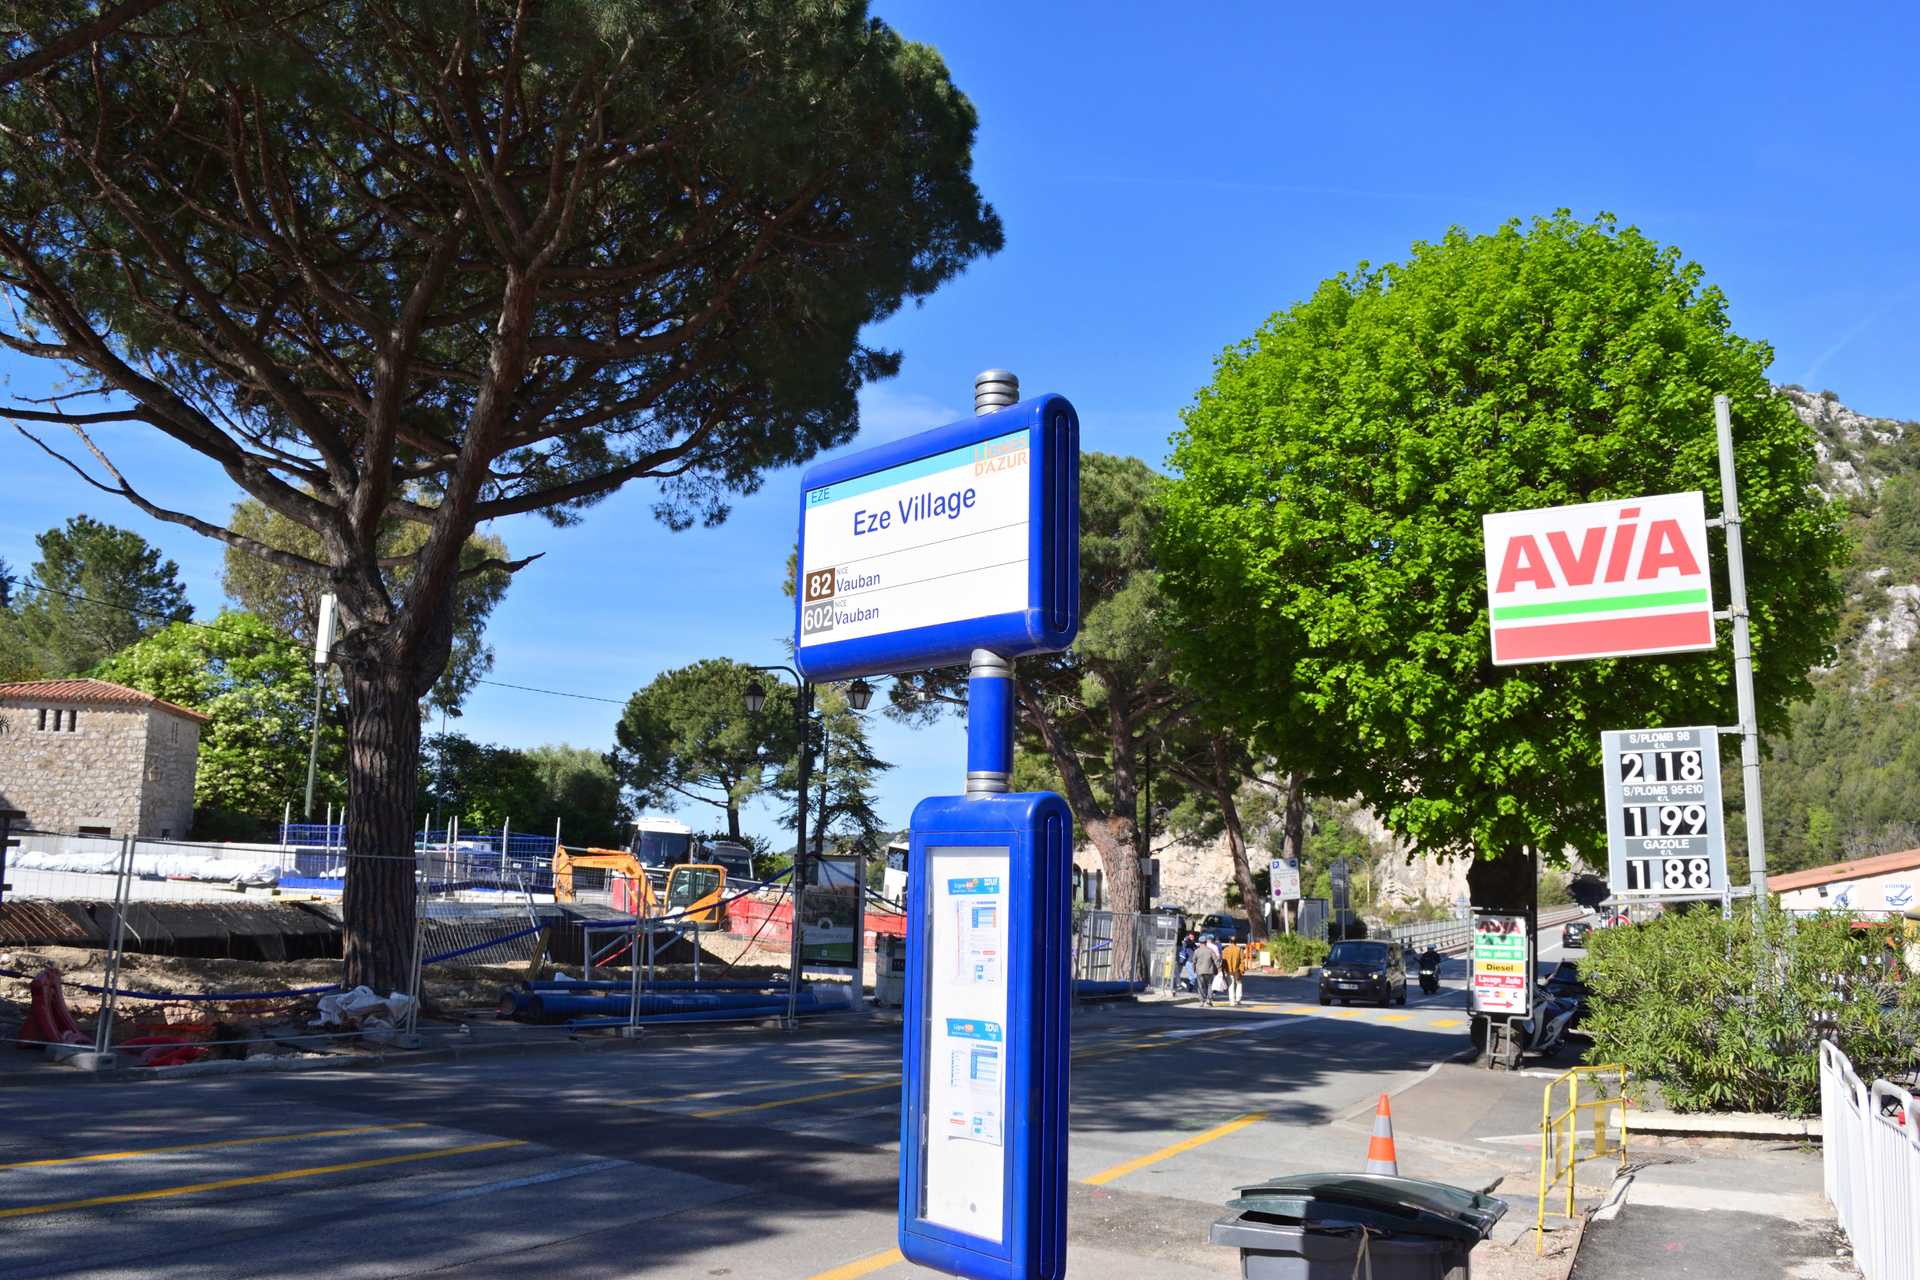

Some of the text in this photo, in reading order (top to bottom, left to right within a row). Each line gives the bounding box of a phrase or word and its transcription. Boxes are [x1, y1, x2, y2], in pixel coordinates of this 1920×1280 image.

[975, 452, 1028, 478] D'AZUR
[811, 487, 831, 504] EZE
[853, 488, 977, 536] Eze Village
[810, 573, 880, 597] 82 Vauban
[804, 605, 879, 631] 602 Vauban
[1629, 731, 1690, 744] S/PLOMB 98
[1621, 750, 1702, 784] 2.18
[1623, 784, 1703, 797] S/PLOMB 95-E10
[1629, 805, 1706, 836] 1.99
[1643, 839, 1690, 850] GAZOLE
[1632, 859, 1710, 889] 1.88
[1479, 975, 1521, 984] Lavage Auto
[1486, 963, 1514, 972] Diesel
